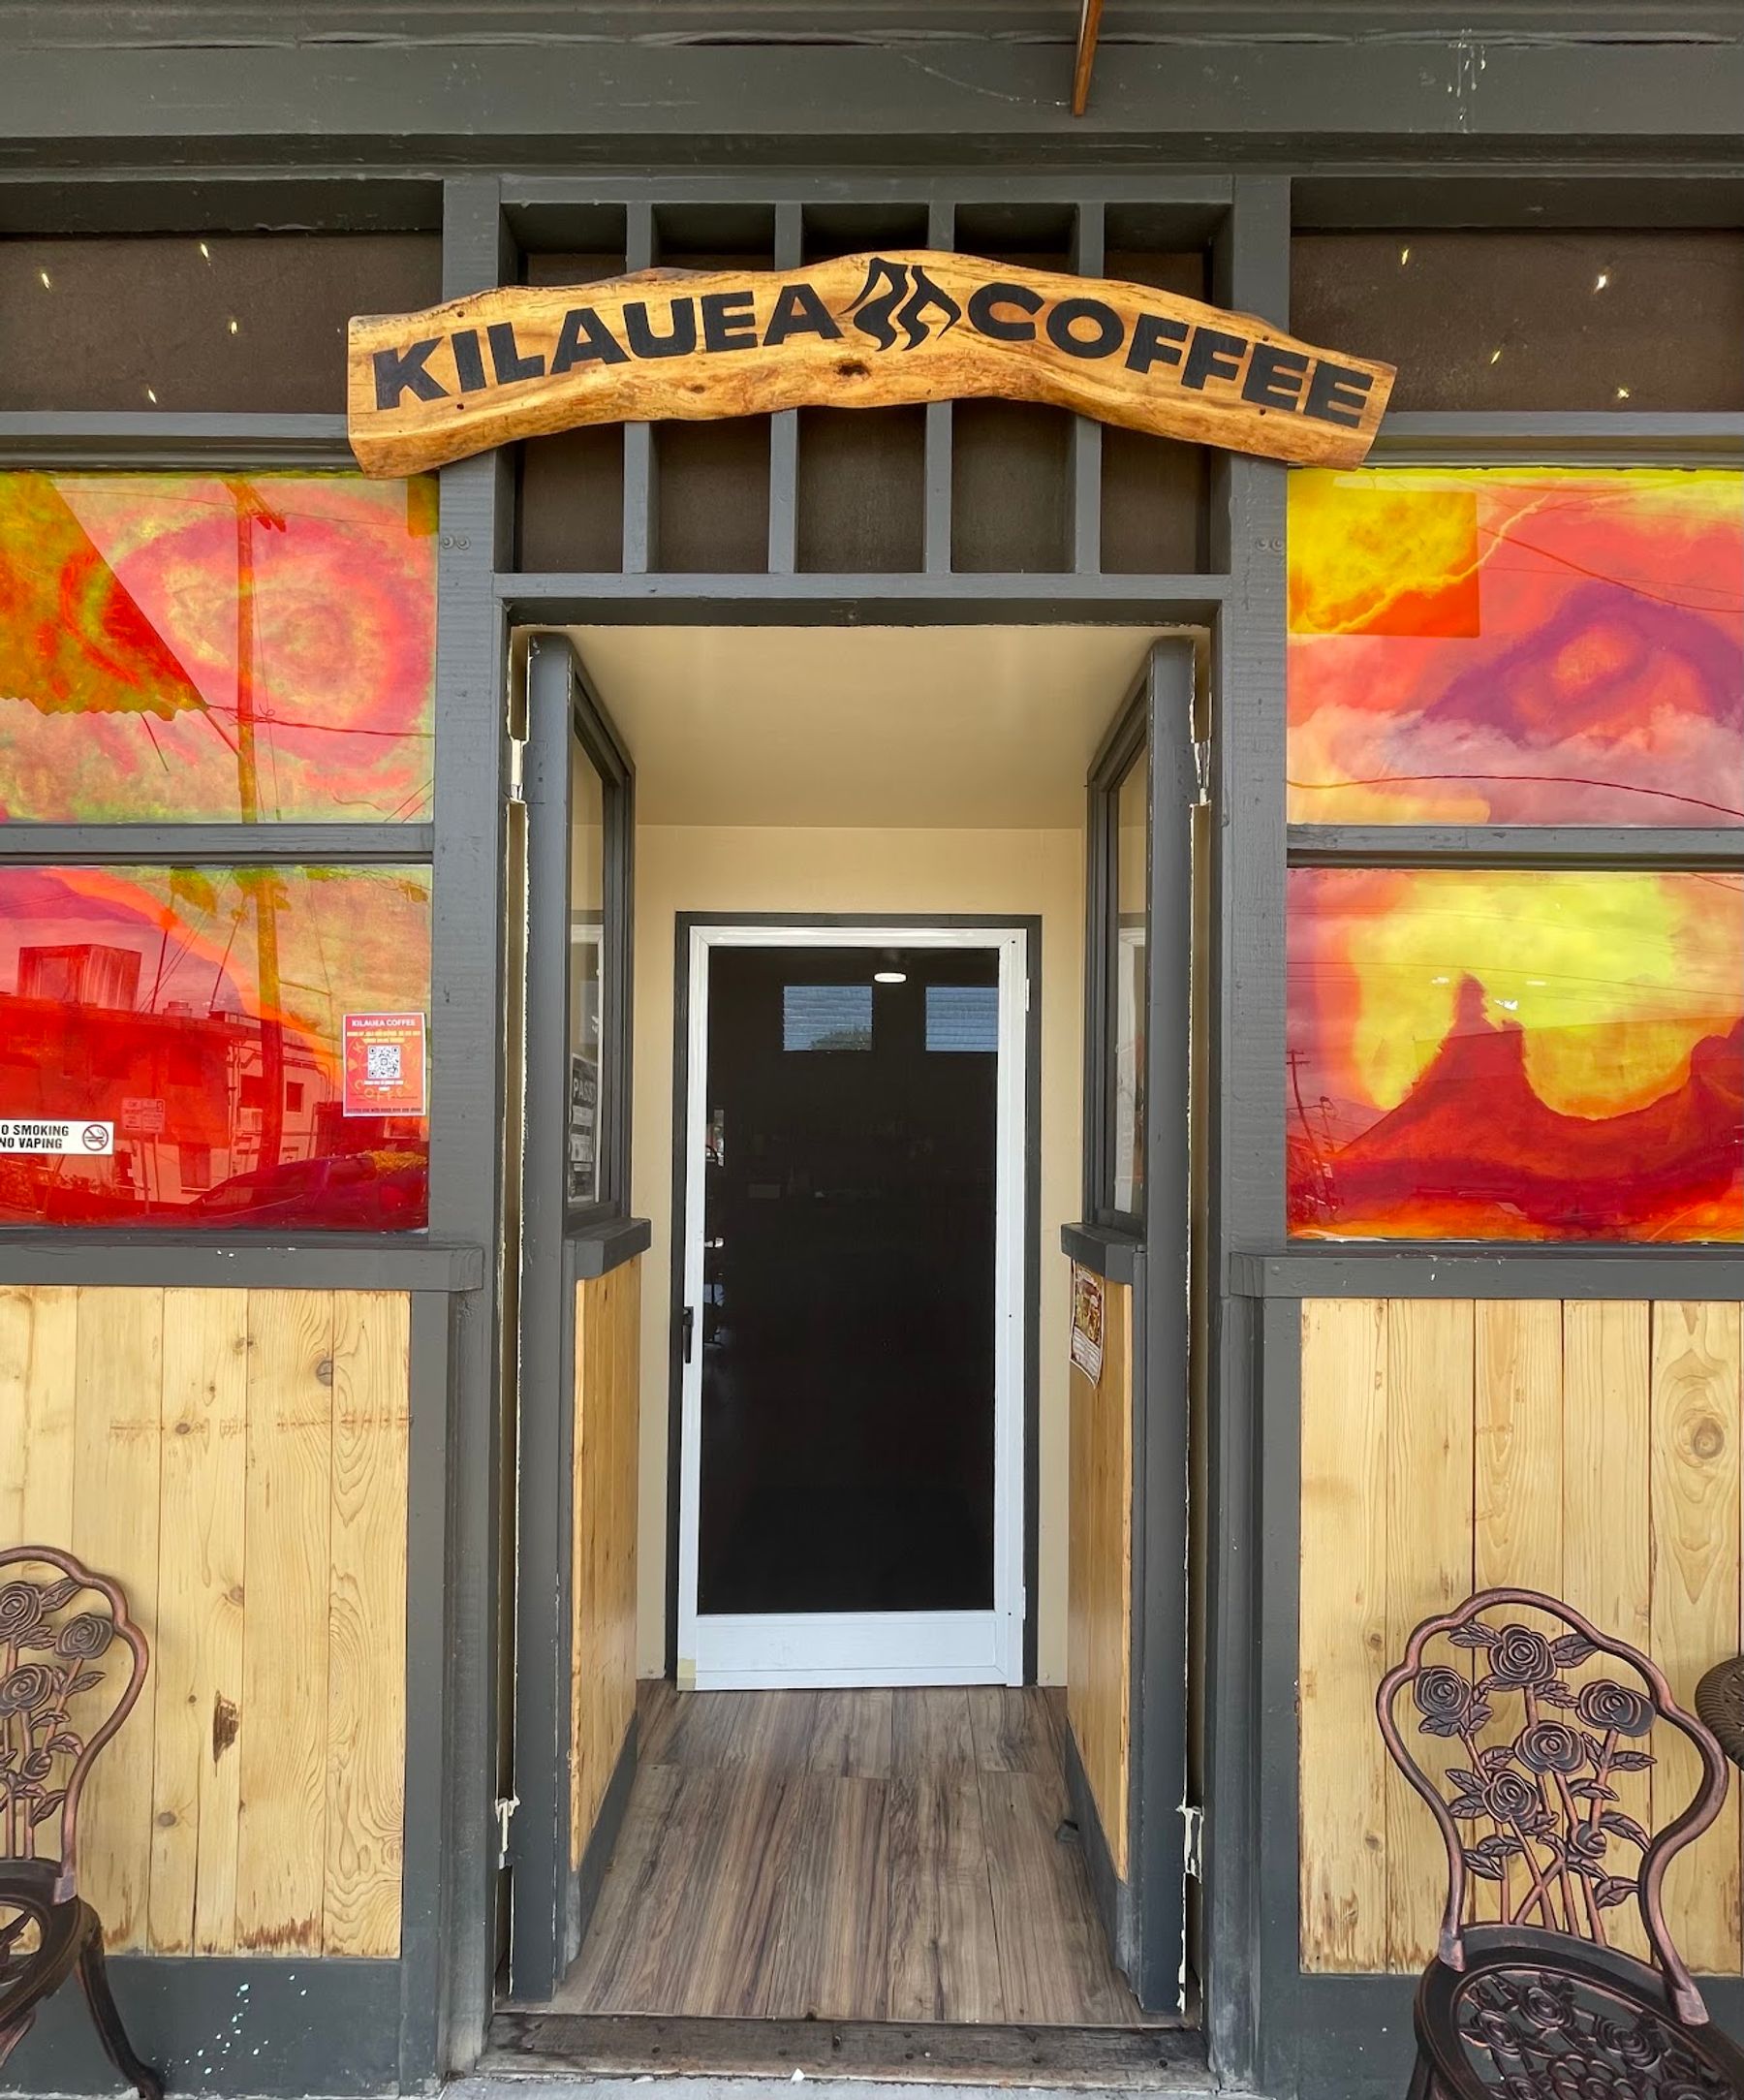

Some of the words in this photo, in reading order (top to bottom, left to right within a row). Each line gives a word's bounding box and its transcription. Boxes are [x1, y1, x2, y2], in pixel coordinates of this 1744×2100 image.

[373, 284, 845, 411] KILAUEA
[968, 282, 1374, 428] COFFEE
[0, 1124, 9, 1135] O
[13, 1124, 70, 1137] SMOKING
[0, 1137, 15, 1148] NO
[18, 1138, 63, 1149] VAPING
